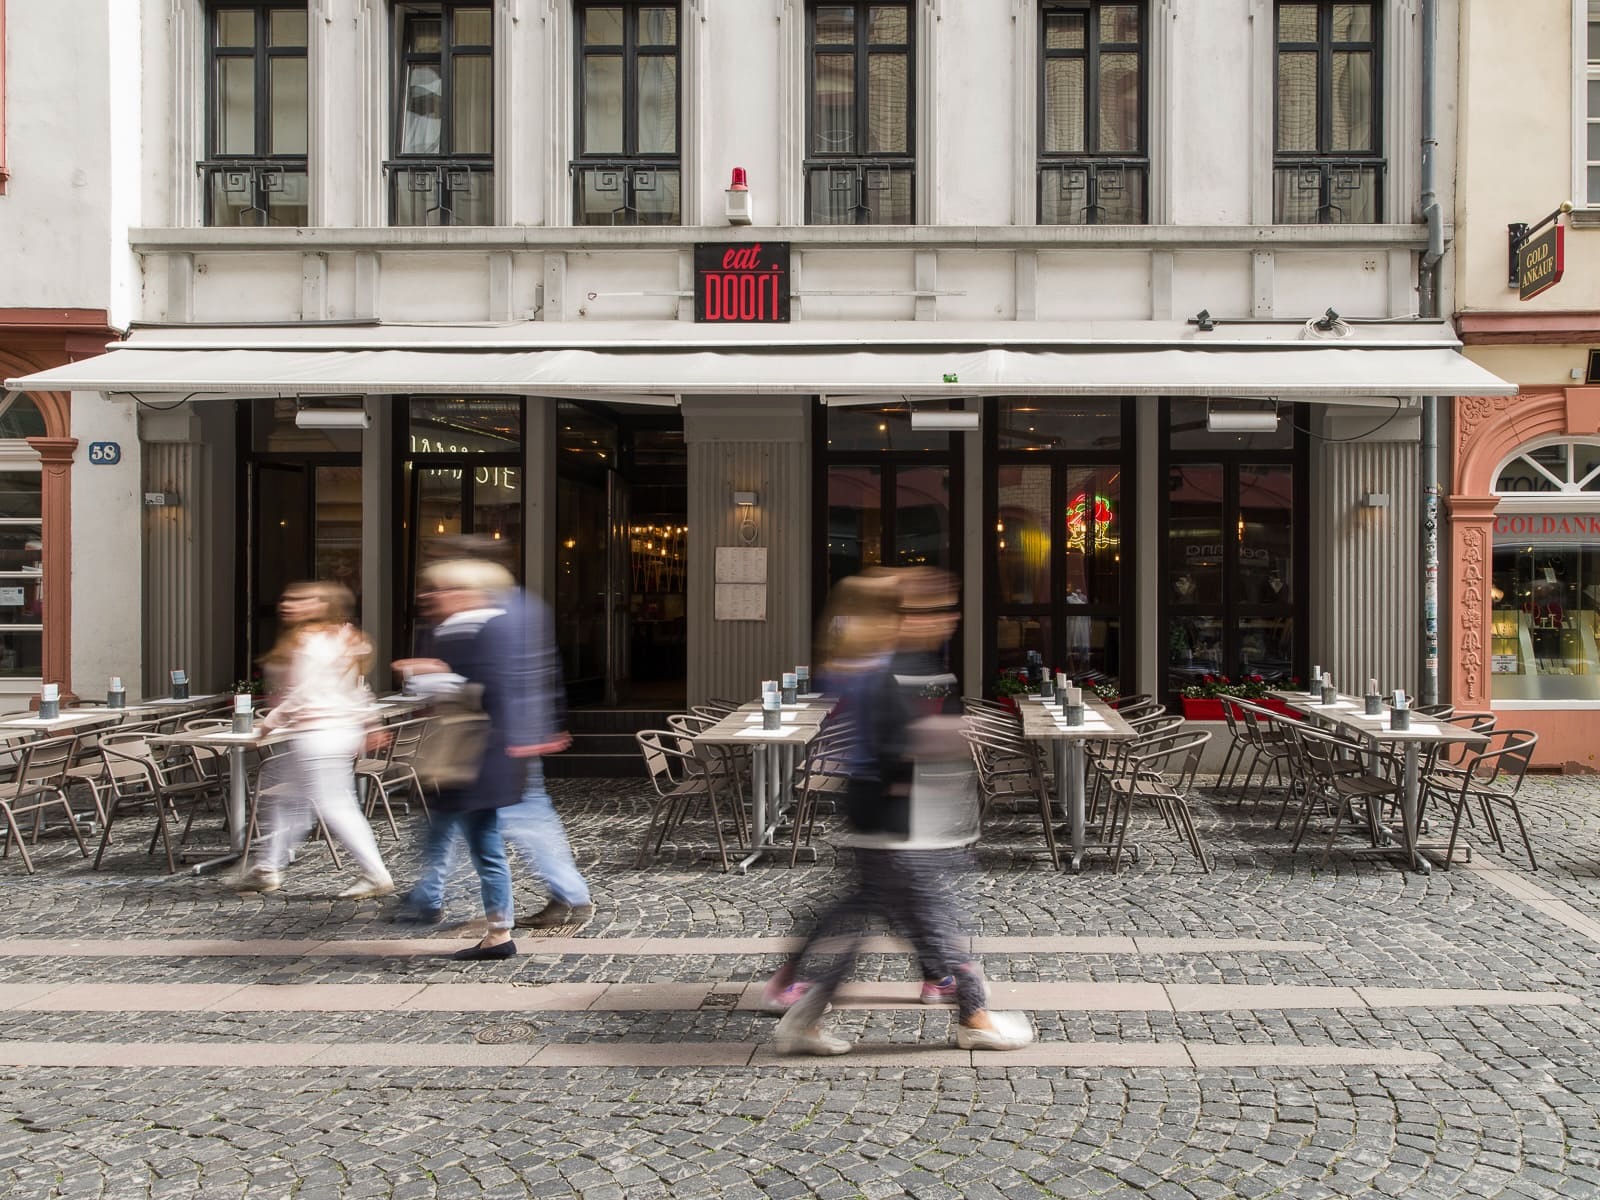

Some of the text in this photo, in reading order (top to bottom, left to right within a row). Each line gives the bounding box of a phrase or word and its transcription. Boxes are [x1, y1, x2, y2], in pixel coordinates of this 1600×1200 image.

[722, 243, 762, 269] eat
[1526, 243, 1549, 268] GOLD
[1522, 256, 1554, 288] ANKAUF
[91, 445, 116, 460] 58
